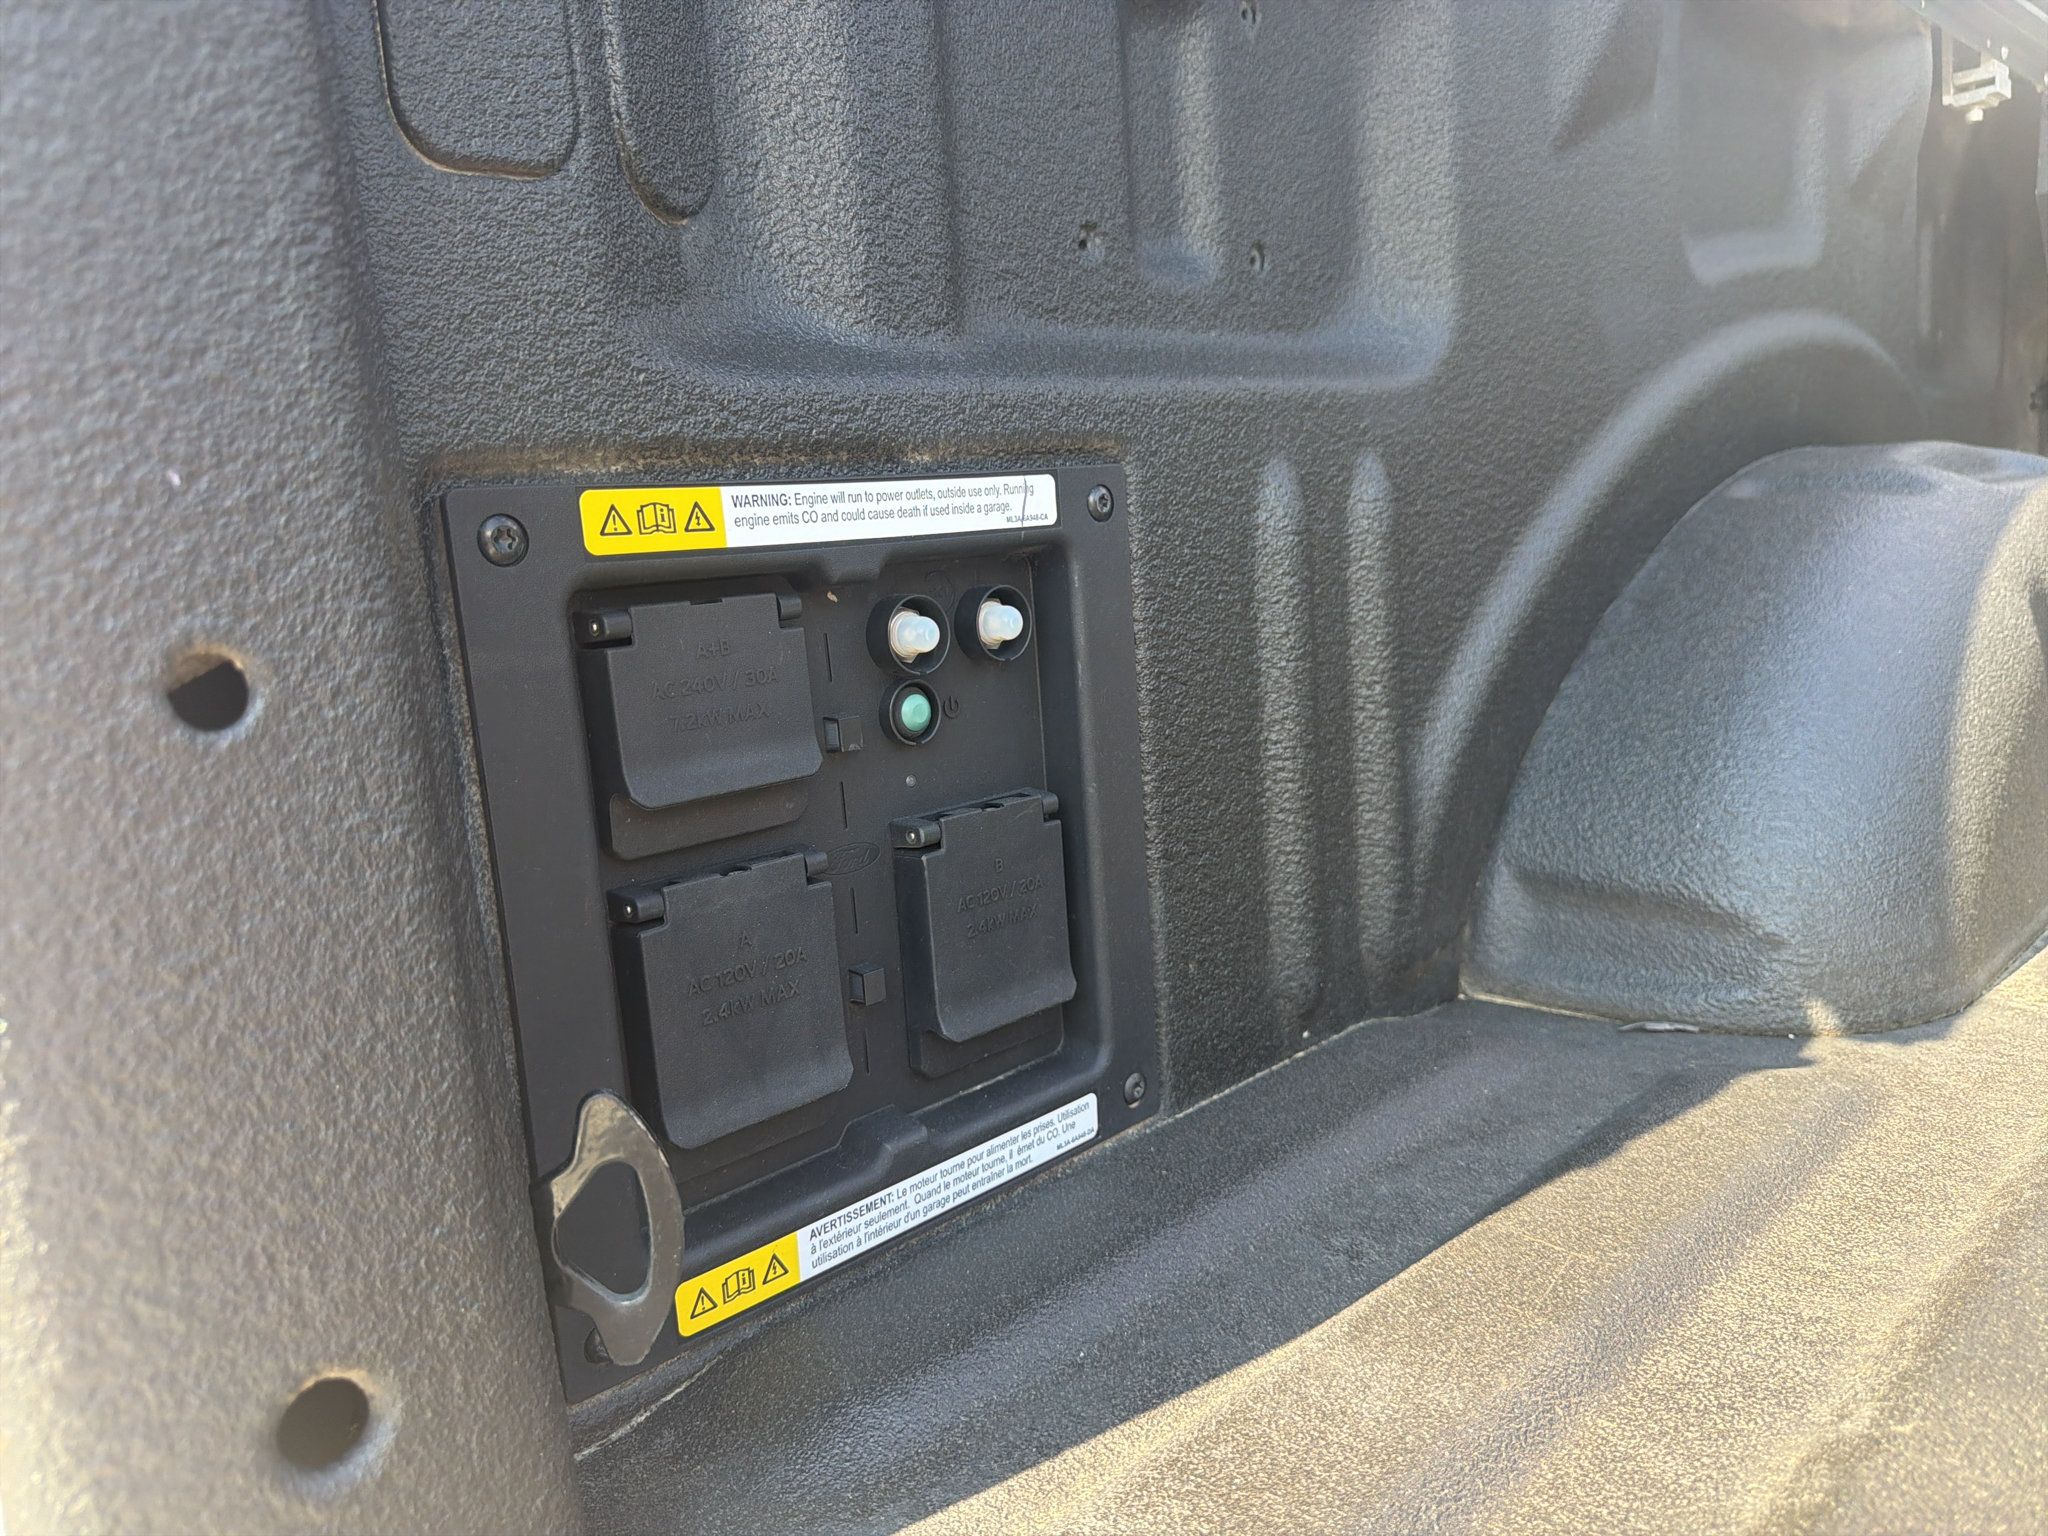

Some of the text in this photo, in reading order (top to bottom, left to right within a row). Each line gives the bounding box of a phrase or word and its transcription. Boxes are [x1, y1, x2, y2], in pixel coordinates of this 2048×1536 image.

[731, 493, 792, 508] WARNING:
[794, 492, 828, 508] Engine
[830, 491, 846, 504] will
[848, 493, 863, 503] run
[864, 490, 874, 502] to
[876, 490, 903, 505] power
[906, 488, 936, 501] outlets,
[938, 486, 967, 499] outside
[968, 487, 982, 498] use
[984, 485, 1002, 500] only.
[734, 501, 1012, 530] engine emits CO and could cause death if used inside a garage.
[995, 857, 1005, 873] B
[1008, 903, 1039, 924] MAX
[738, 929, 753, 950] A
[774, 946, 808, 970] 20A
[760, 978, 802, 1005] MAX
[809, 1102, 1090, 1242] AVERTISSEMENT: Le moteur tourne pour alimenter les prises. Utilisation
[810, 1120, 1076, 1255] à l'extérieur seulement. Quand le moteur tourne, il émet du CO. Une
[811, 1154, 1034, 1270] utilisation à l'intérieur d'un garage peut entraîner la mort.
